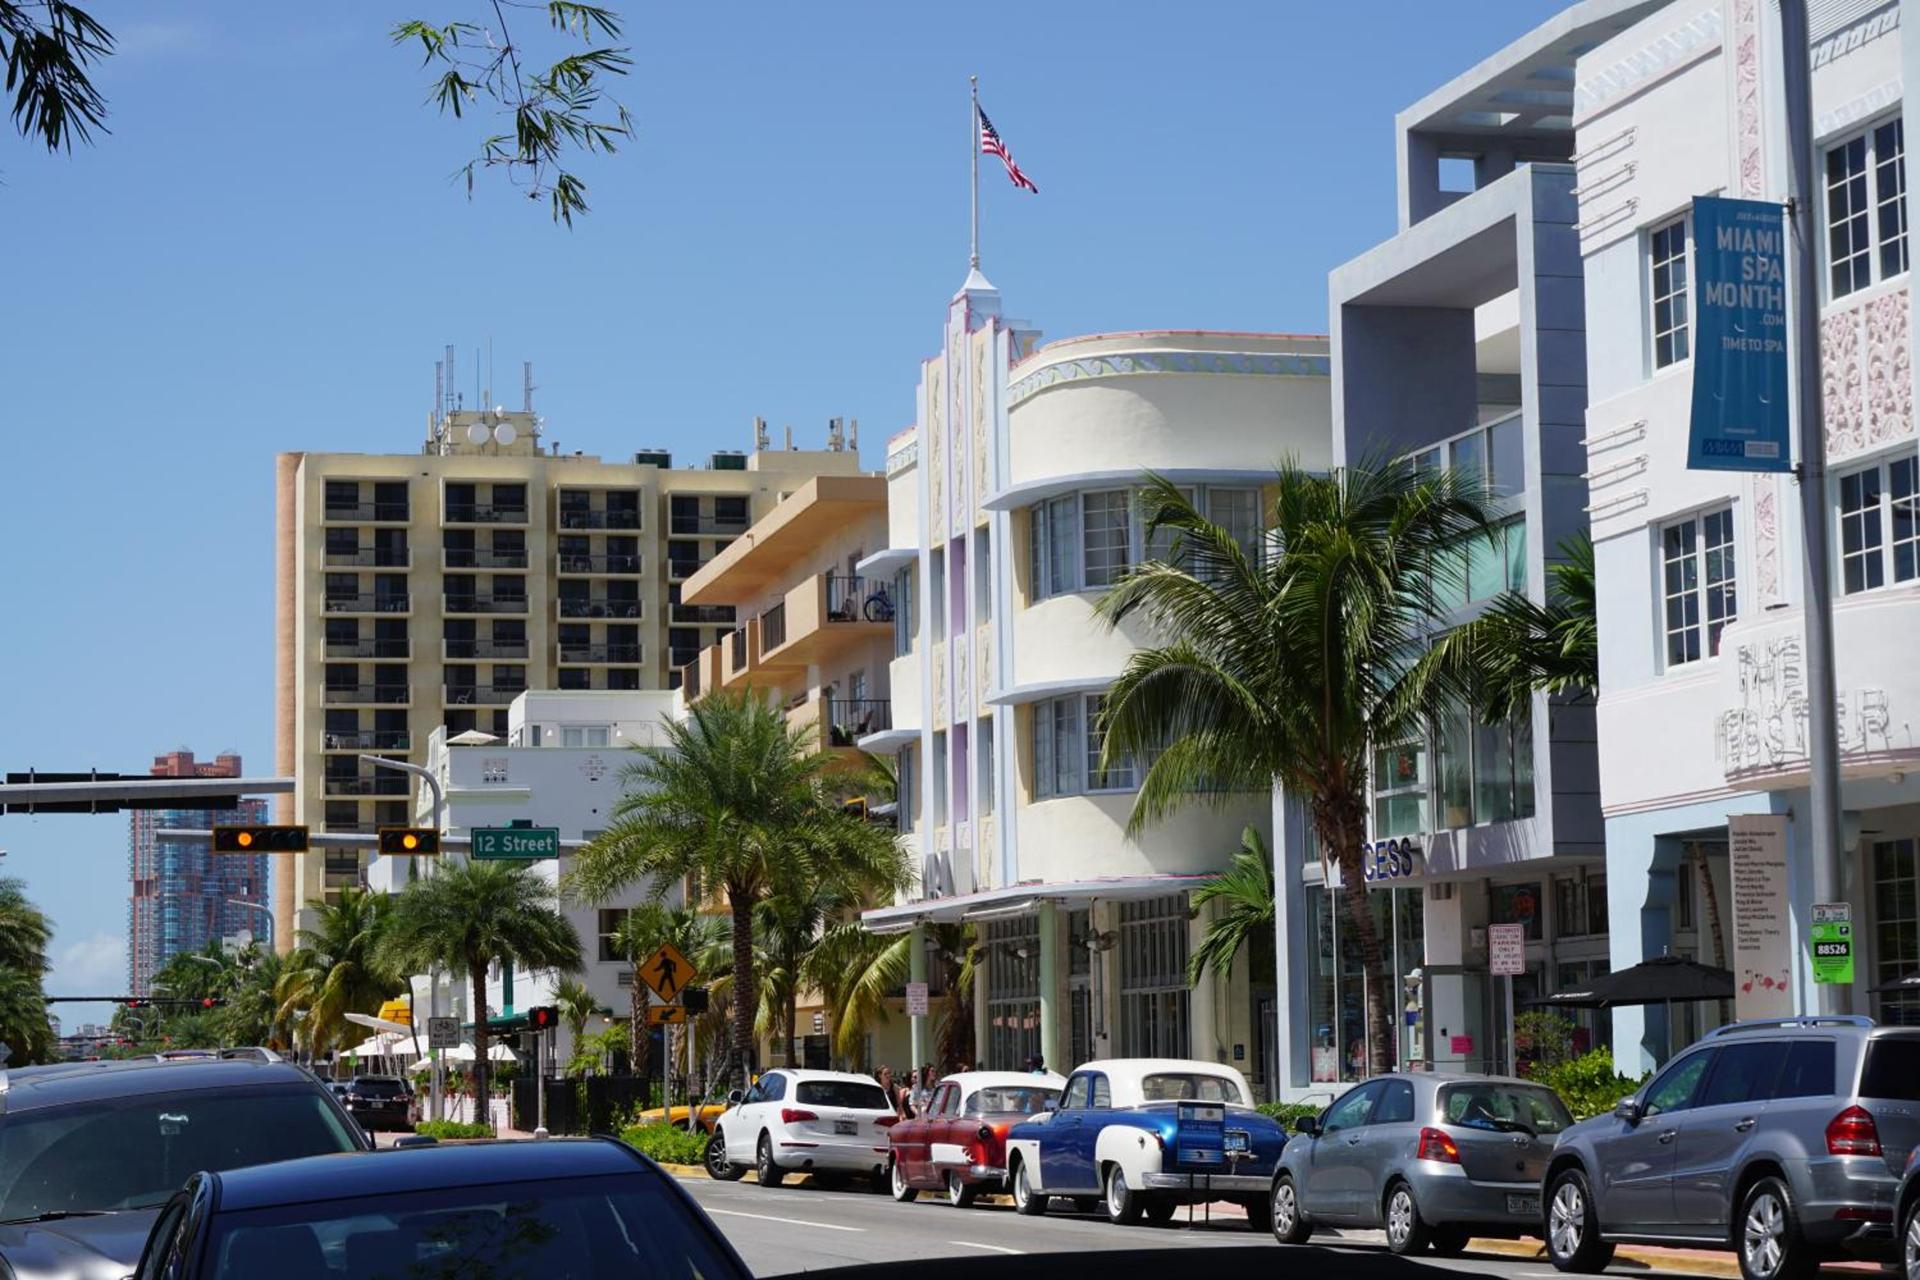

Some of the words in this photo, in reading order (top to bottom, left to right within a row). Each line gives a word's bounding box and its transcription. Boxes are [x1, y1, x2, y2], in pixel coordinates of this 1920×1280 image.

[1717, 225, 1781, 255] MIAMI
[1742, 255, 1783, 283] SPA
[1705, 280, 1783, 311] MONTH
[1764, 339, 1785, 353] SPA
[478, 835, 496, 852] 12
[502, 835, 553, 852] Street
[1361, 837, 1412, 881] CESS
[1817, 944, 1847, 955] 88526
